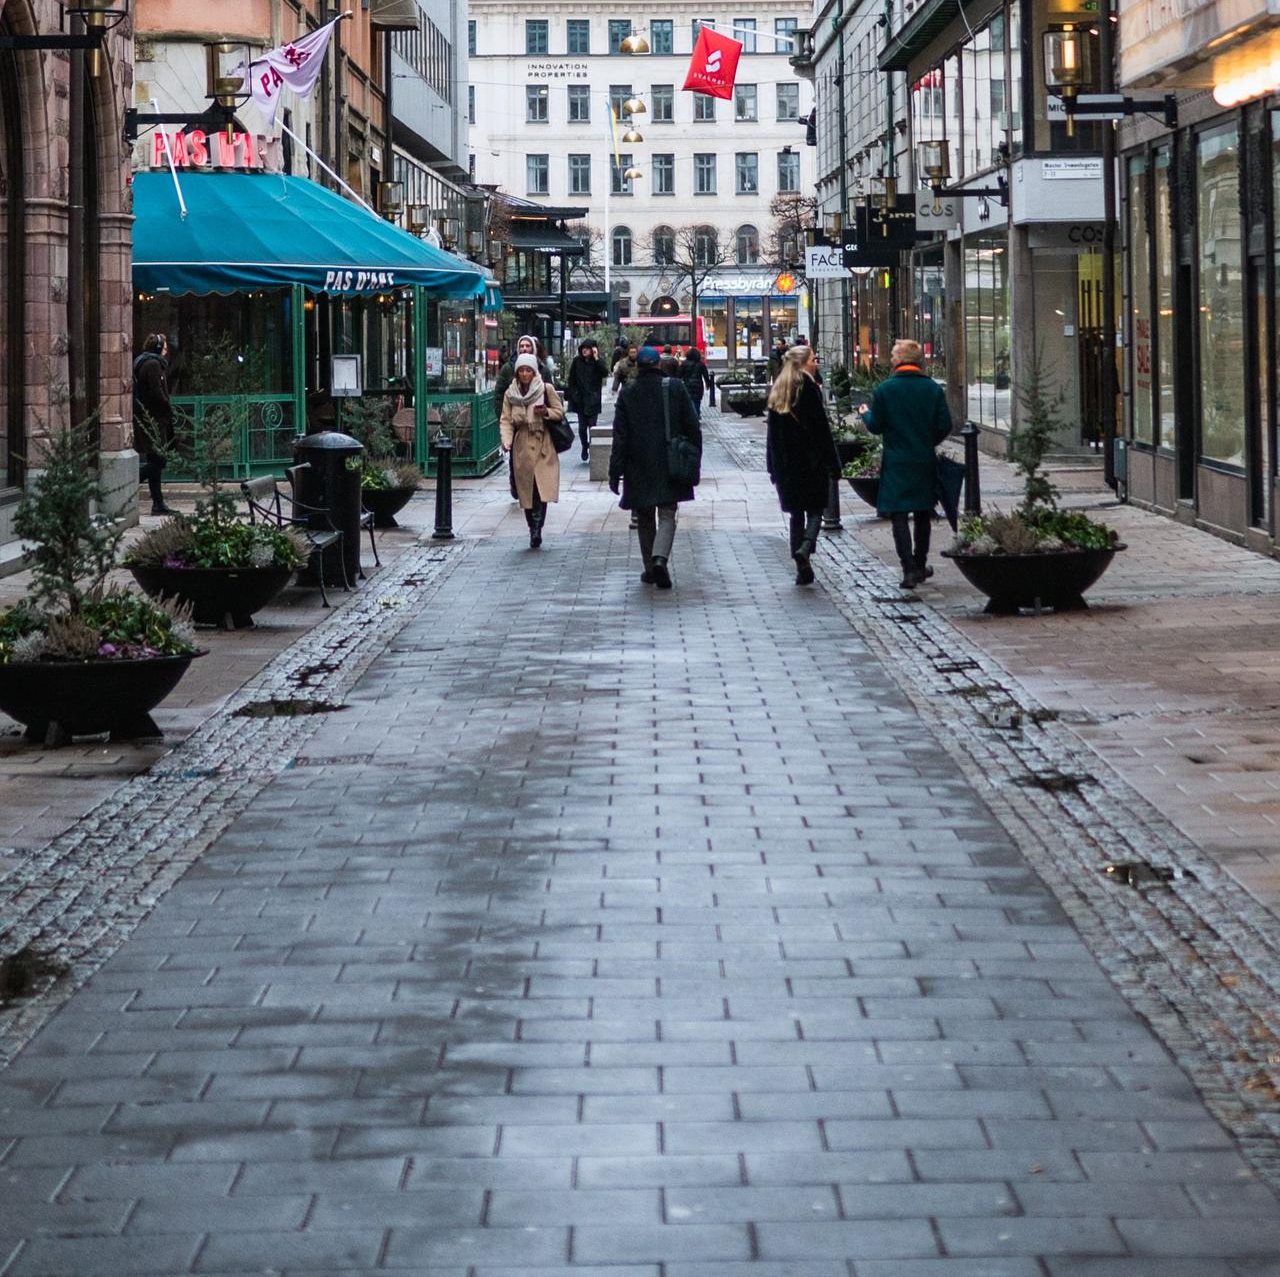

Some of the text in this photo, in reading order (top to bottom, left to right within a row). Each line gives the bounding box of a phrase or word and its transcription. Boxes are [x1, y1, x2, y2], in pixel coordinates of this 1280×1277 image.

[153, 130, 208, 167] PAS
[919, 204, 954, 217] COS
[323, 270, 395, 291] PAS D'ART
[703, 275, 773, 292] Pressbyrån
